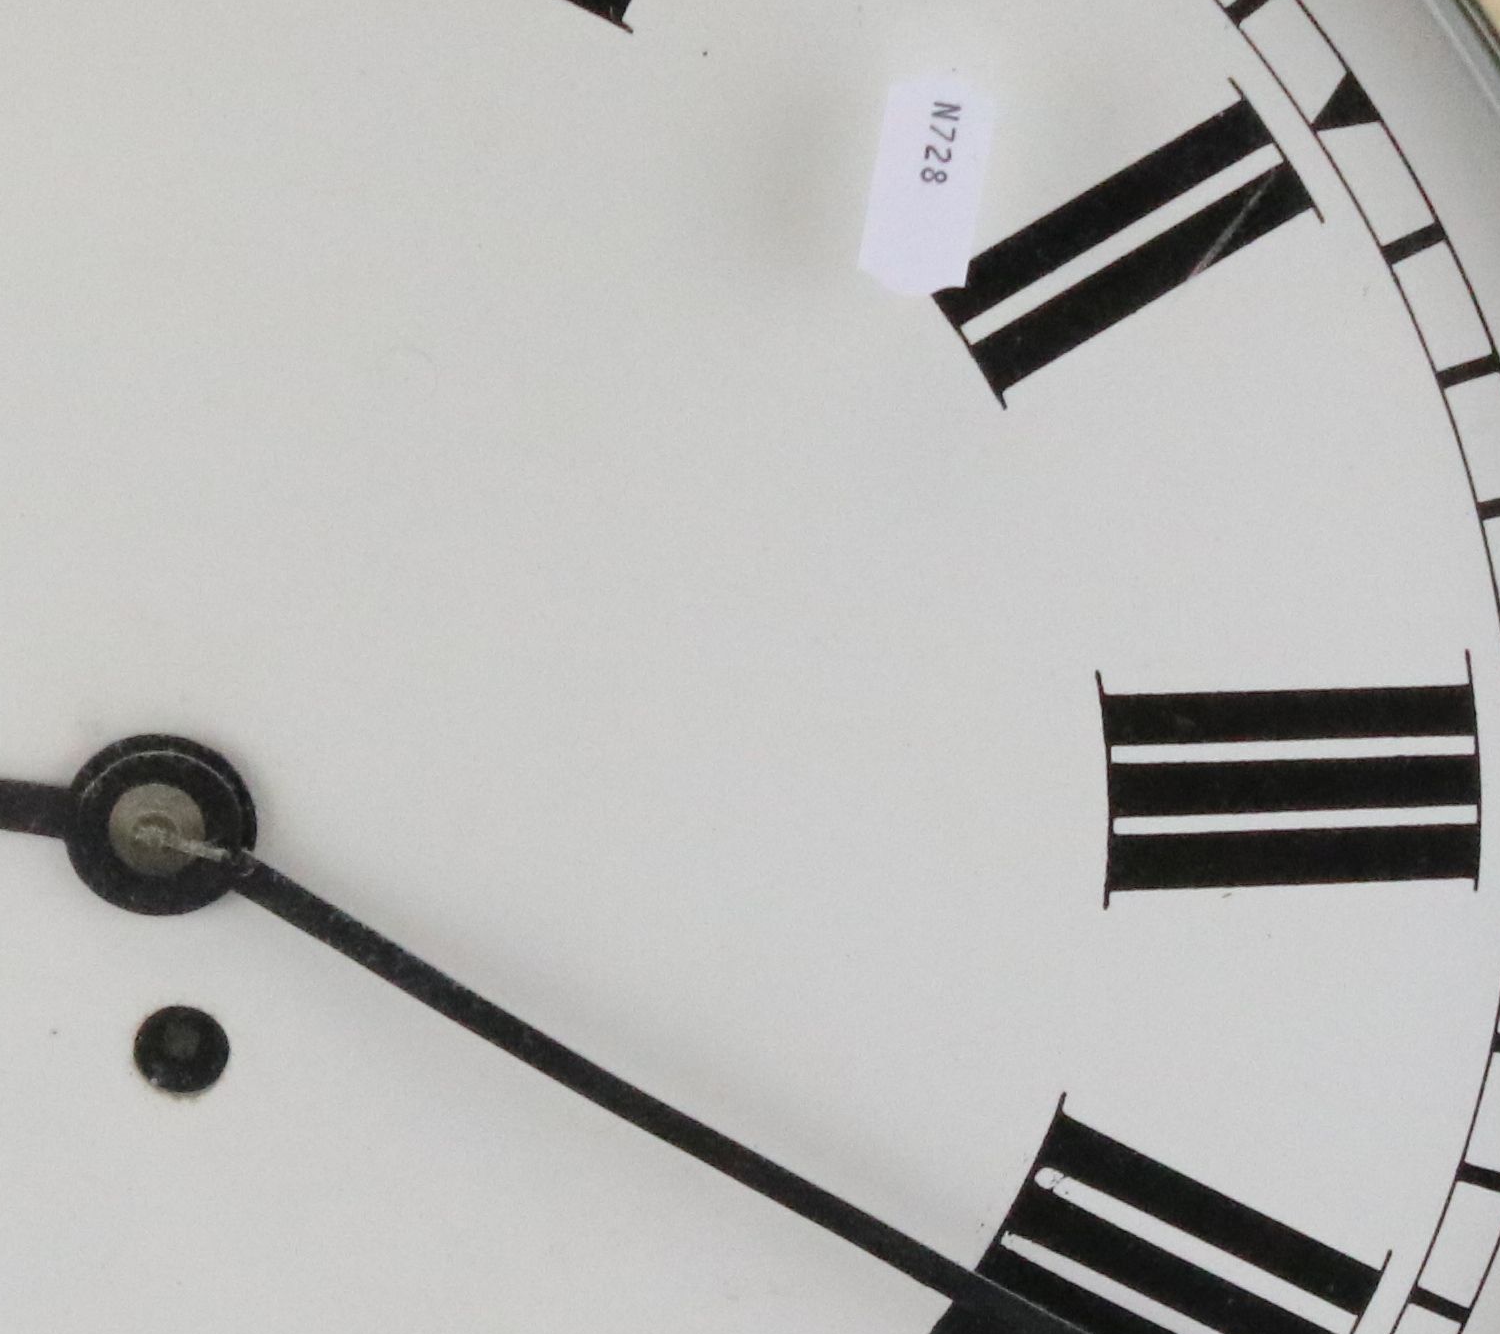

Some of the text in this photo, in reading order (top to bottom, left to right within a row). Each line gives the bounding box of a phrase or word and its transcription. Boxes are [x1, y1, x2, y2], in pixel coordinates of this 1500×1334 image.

[921, 101, 962, 183] N728
[931, 77, 1324, 410] II
[1095, 649, 1482, 910] III
